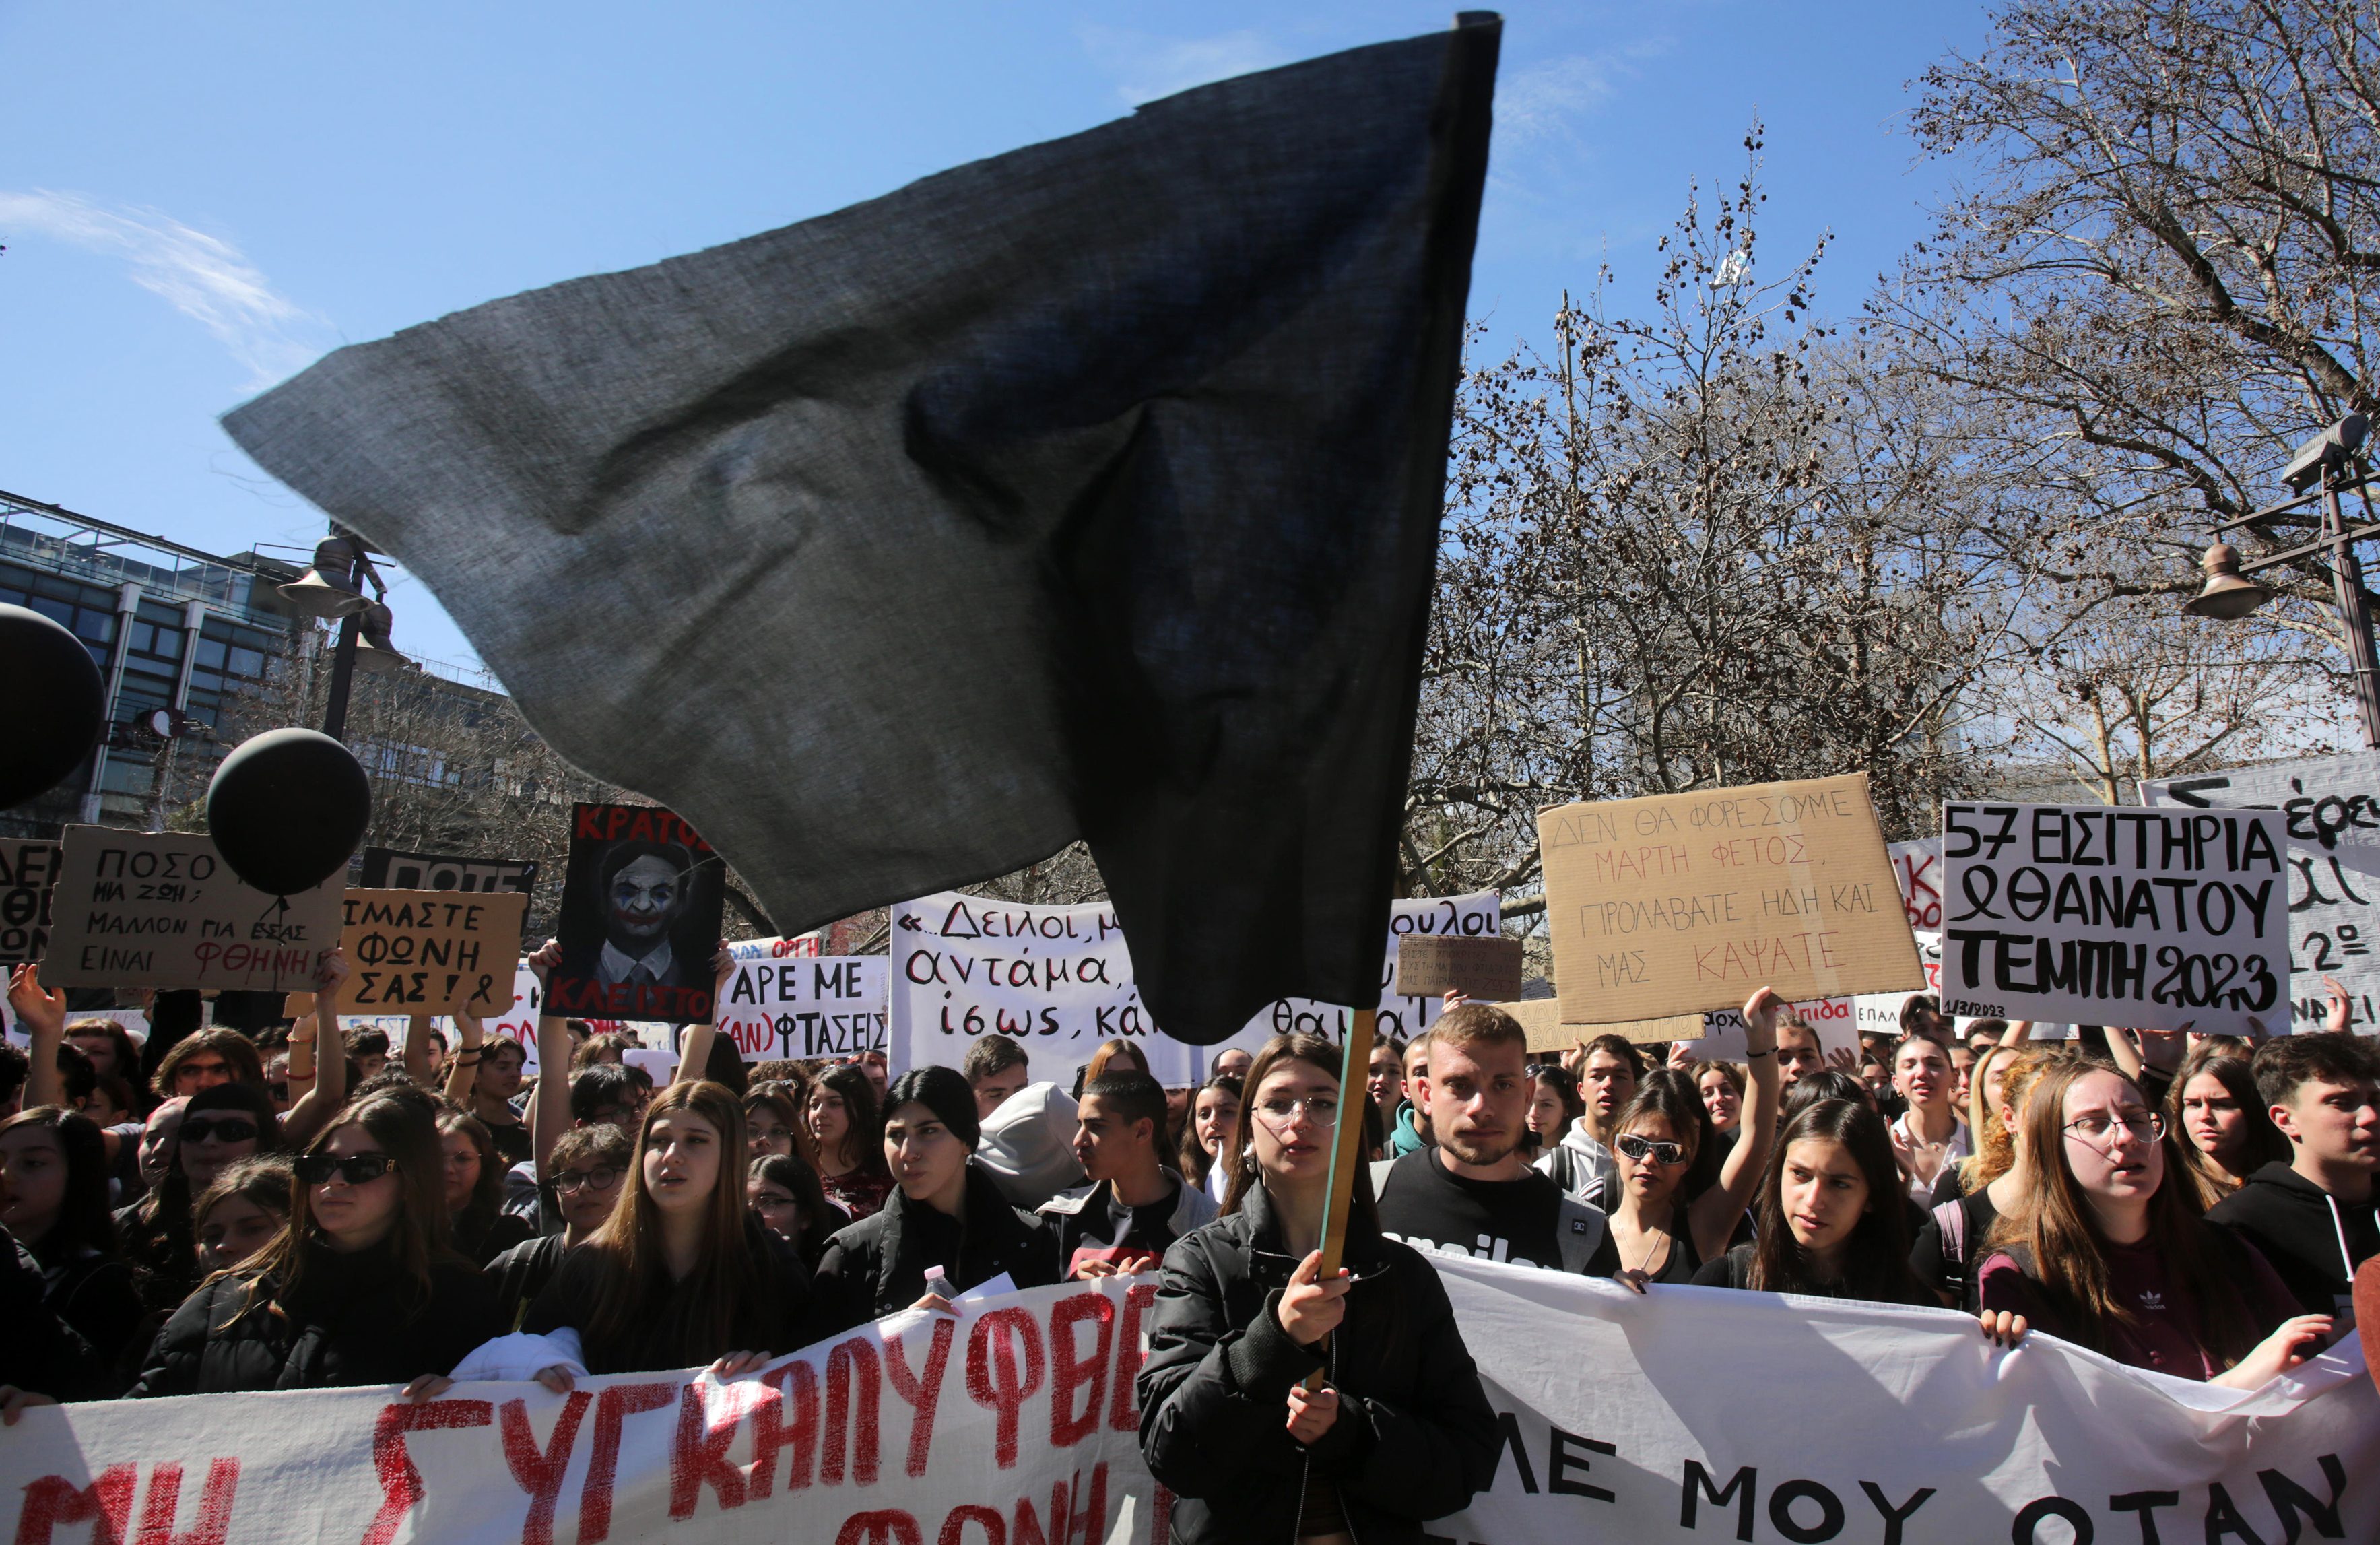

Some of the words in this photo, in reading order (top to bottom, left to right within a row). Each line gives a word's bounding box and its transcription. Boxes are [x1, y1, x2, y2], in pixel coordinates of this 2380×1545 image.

[1552, 812, 1618, 847] ΔΕΝ
[1635, 807, 1678, 836] ΘΑ
[1690, 790, 1853, 832] ΦΟΡΕΣΟΥΜΕ
[1595, 844, 1690, 884] ΜΑΡΤΗ
[1712, 834, 1826, 868] ΦΕΤΟΣ,
[1945, 806, 2019, 860] 57
[2032, 808, 2282, 873] ΕΙΣΙΤΗΡΙΑ
[96, 849, 216, 880] ΠΟΣΟ
[92, 881, 125, 902] ΜΙΑ
[1580, 892, 1742, 938] ΠΡΟΛΑΒΑΤΕ
[1762, 886, 1820, 916] ΗΔΗ
[1830, 884, 1879, 913] ΚΑΙ
[2006, 866, 2274, 939] ΘΑΝΑΤΟΥ
[87, 911, 189, 935] ΜΑΛΛΟΝ
[201, 919, 235, 938] ΓΙΑ
[250, 921, 308, 941] ΕΣΑΣ
[343, 900, 486, 931] ΙΜΑΣΤΕ
[1391, 900, 1496, 936] ουλοι
[81, 945, 154, 971] ΕΙΝΑΙ
[194, 942, 310, 977] ΦΘΗΝΗ
[356, 931, 480, 972] ΦΩΝΗ
[1597, 950, 1651, 988] ΜΑΣ
[1694, 931, 1847, 982] ΚΑΨΑΤΕ
[1947, 929, 2148, 1001] ΤΕΜΠΗ
[2152, 945, 2279, 1012] 2023
[548, 977, 710, 1018] ΚΛΕΙΣΤΟ
[730, 965, 797, 1004] ΑΡΕ
[814, 962, 862, 1000] ΜΕ
[1944, 999, 2006, 1018] 1/3/2023
[1526, 1024, 1583, 1051] ΒΟΛΟ
[359, 1284, 1160, 1545] ΣΥΓΚΑΛΥΦΘΕ
[1680, 1459, 1938, 1545] ΜΟΥ
[2011, 1453, 2346, 1545] ΟΤΑΝ
